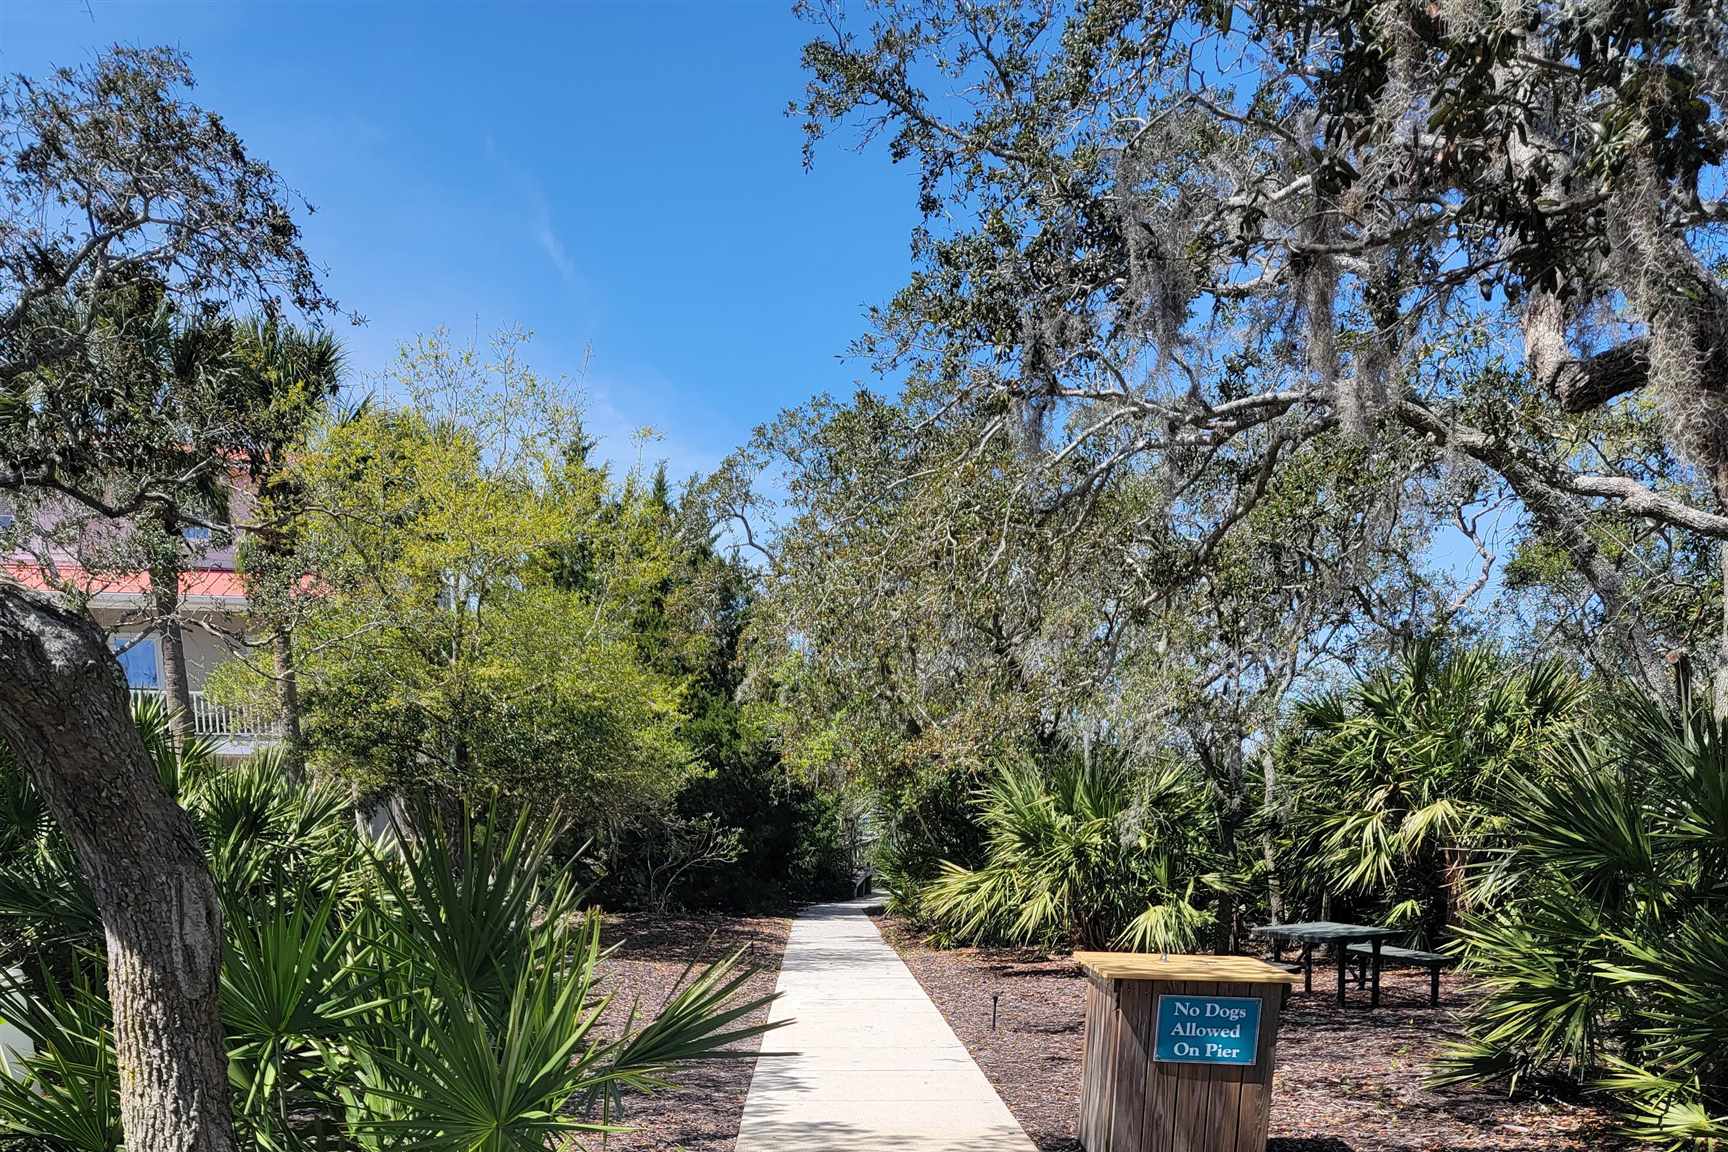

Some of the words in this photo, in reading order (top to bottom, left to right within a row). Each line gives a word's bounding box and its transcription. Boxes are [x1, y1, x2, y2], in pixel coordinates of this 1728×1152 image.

[1173, 1002, 1200, 1017] No
[1204, 1003, 1247, 1021] Dogs
[1170, 1022, 1240, 1038] Allowed
[1173, 1042, 1200, 1057] On
[1205, 1043, 1240, 1058] Pier
